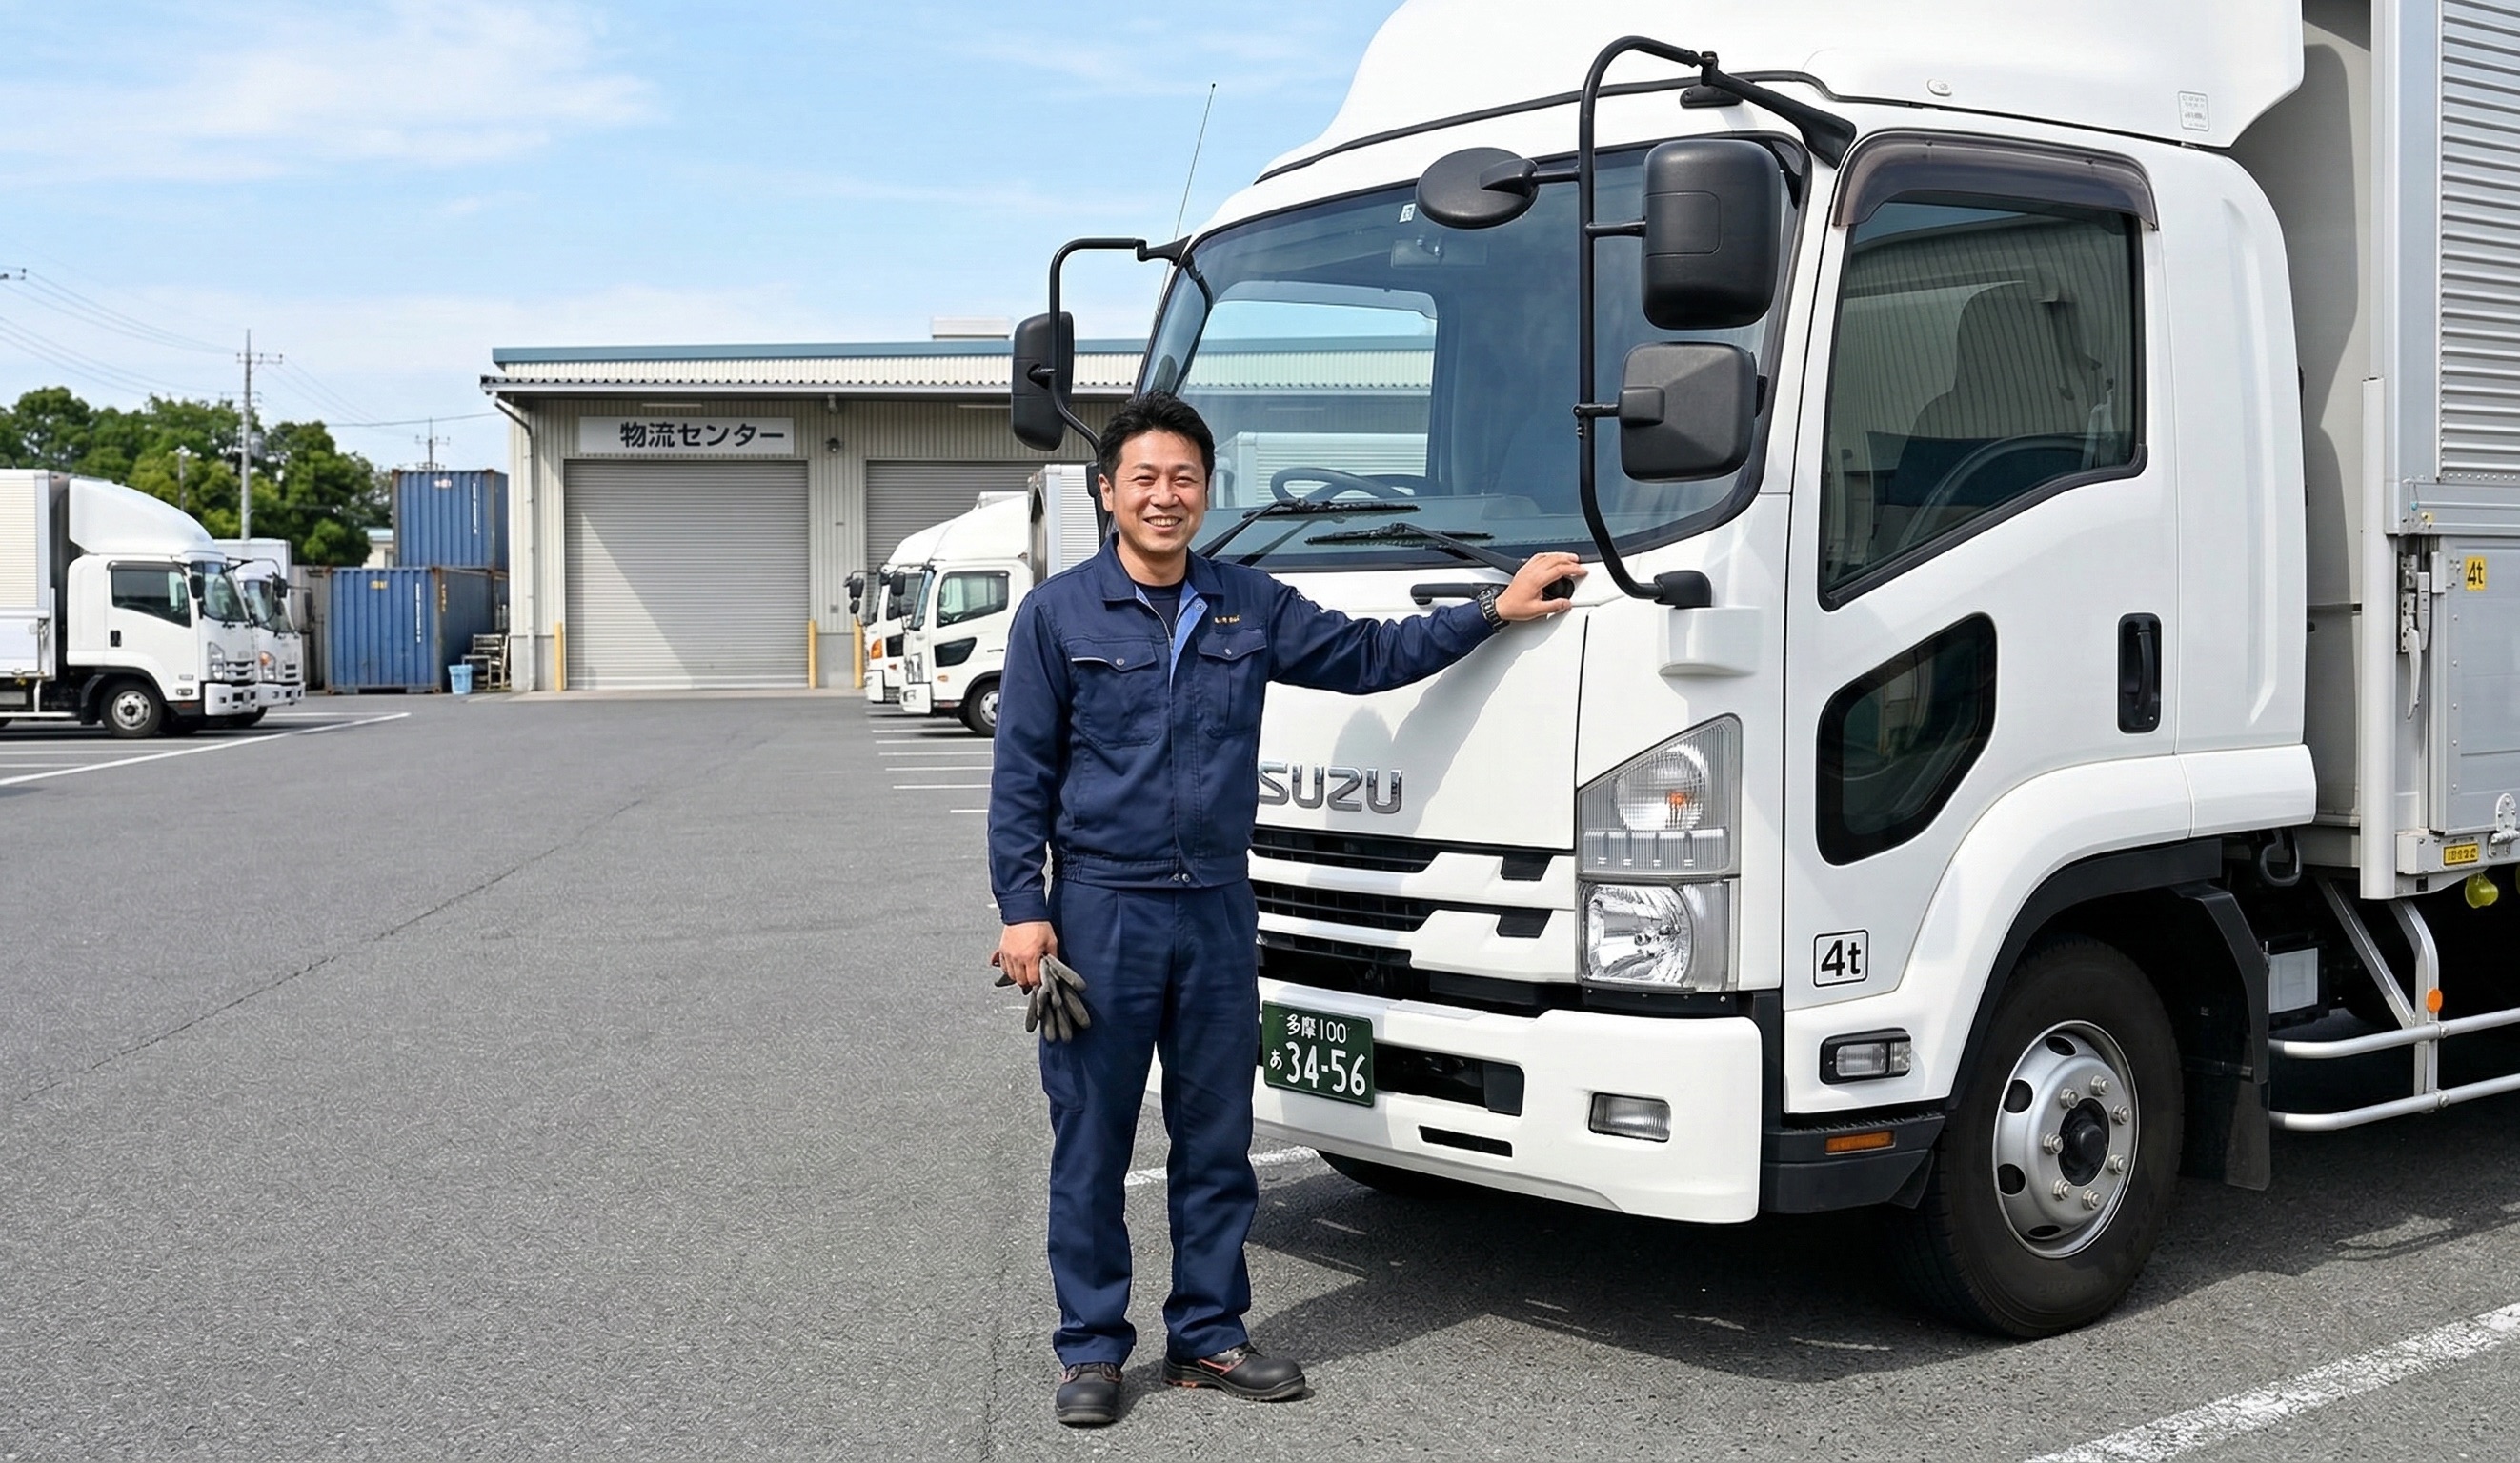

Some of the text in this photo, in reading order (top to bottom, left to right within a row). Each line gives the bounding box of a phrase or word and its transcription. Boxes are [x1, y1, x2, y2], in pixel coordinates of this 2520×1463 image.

[620, 421, 784, 448] 物流センター
[2467, 561, 2483, 585] 4t
[1259, 761, 1403, 815] SUZU
[1821, 939, 1861, 977] 4t
[1320, 1018, 1347, 1044] 100
[1285, 1040, 1366, 1097] 34-56
